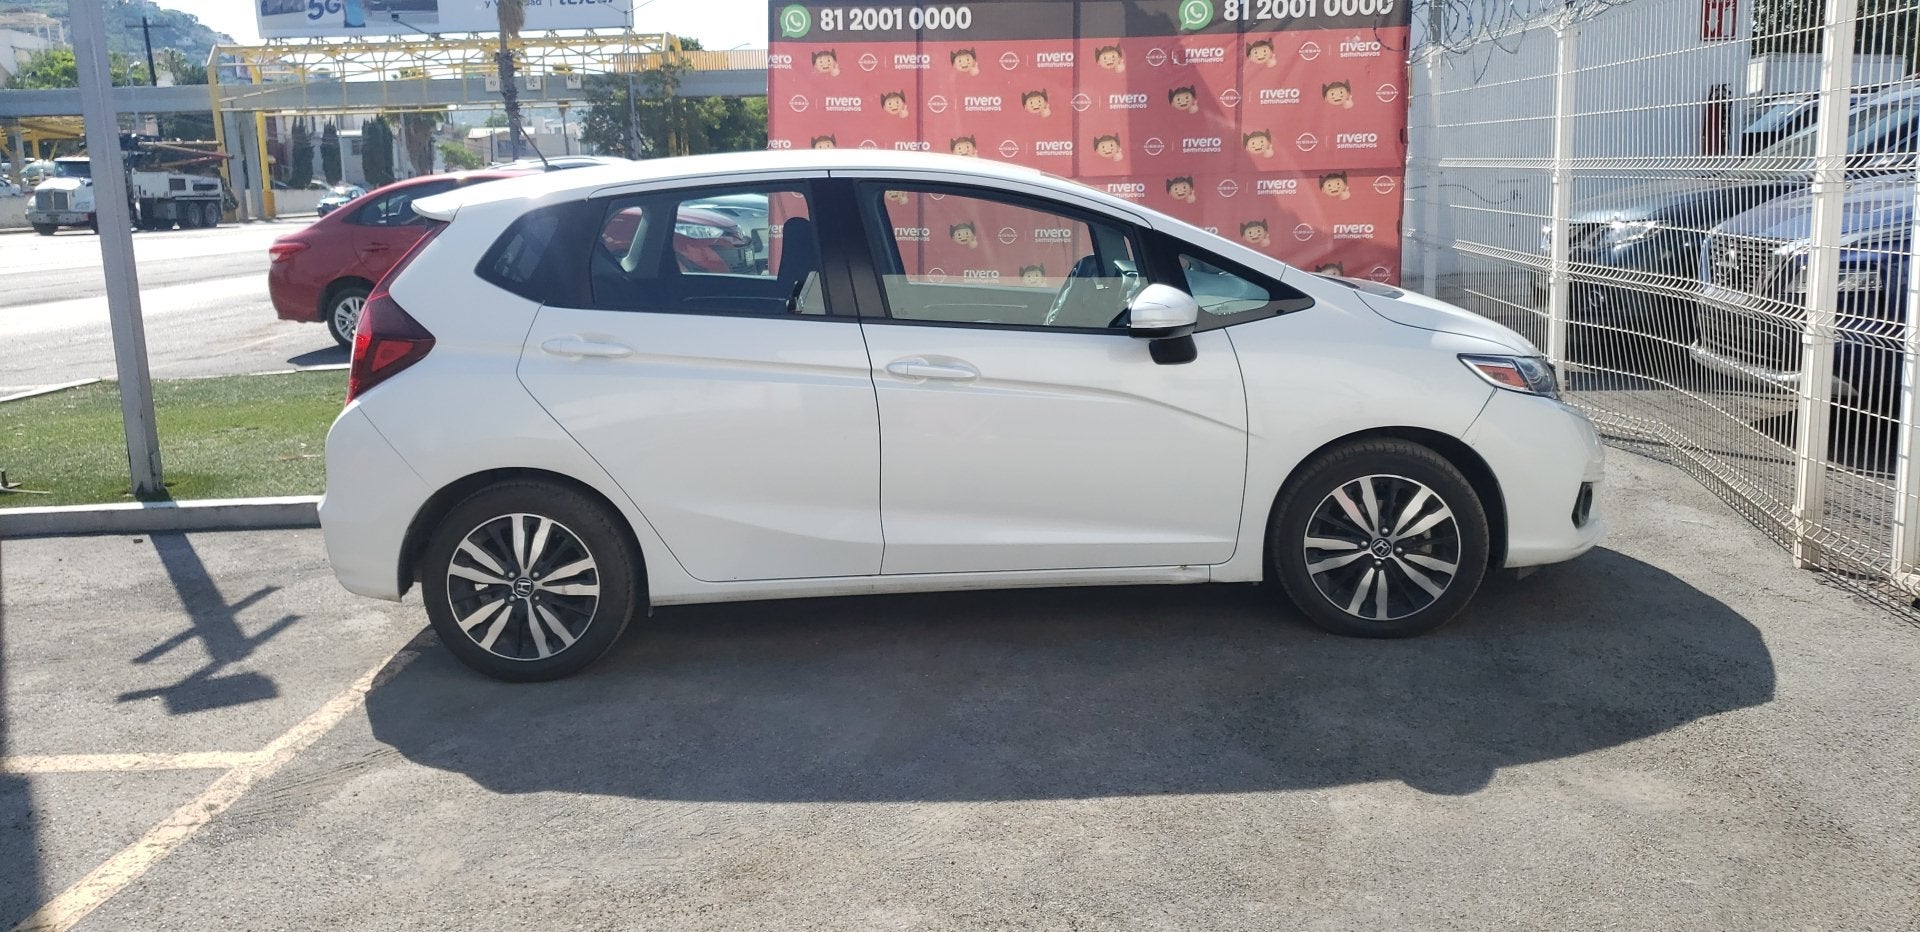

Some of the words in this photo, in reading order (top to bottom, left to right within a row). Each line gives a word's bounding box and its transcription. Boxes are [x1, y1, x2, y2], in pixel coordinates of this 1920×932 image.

[308, 0, 342, 20] 5G
[1223, 0, 1249, 21] 81
[1256, 0, 1317, 20] 2001
[820, 7, 844, 31] 81
[849, 7, 903, 31] 2001
[908, 6, 972, 30] 0000
[1340, 41, 1381, 52] rivero
[1036, 52, 1074, 63] rivero
[1185, 48, 1224, 58] rivero
[894, 54, 930, 64] rivero
[1109, 93, 1148, 104] rivero
[1260, 88, 1300, 99] rivero
[825, 96, 861, 106] rivero
[964, 95, 1002, 106] rivero
[1182, 137, 1222, 148] rivero
[1337, 132, 1378, 143] rivero
[895, 141, 930, 151] rivero
[1036, 140, 1073, 151] rivero
[1107, 182, 1145, 193] rivero
[1257, 179, 1297, 190] rivero
[894, 227, 930, 236] rivero
[1035, 228, 1071, 238] rivero
[1333, 223, 1374, 234] rivero
[963, 269, 999, 279] rivero
